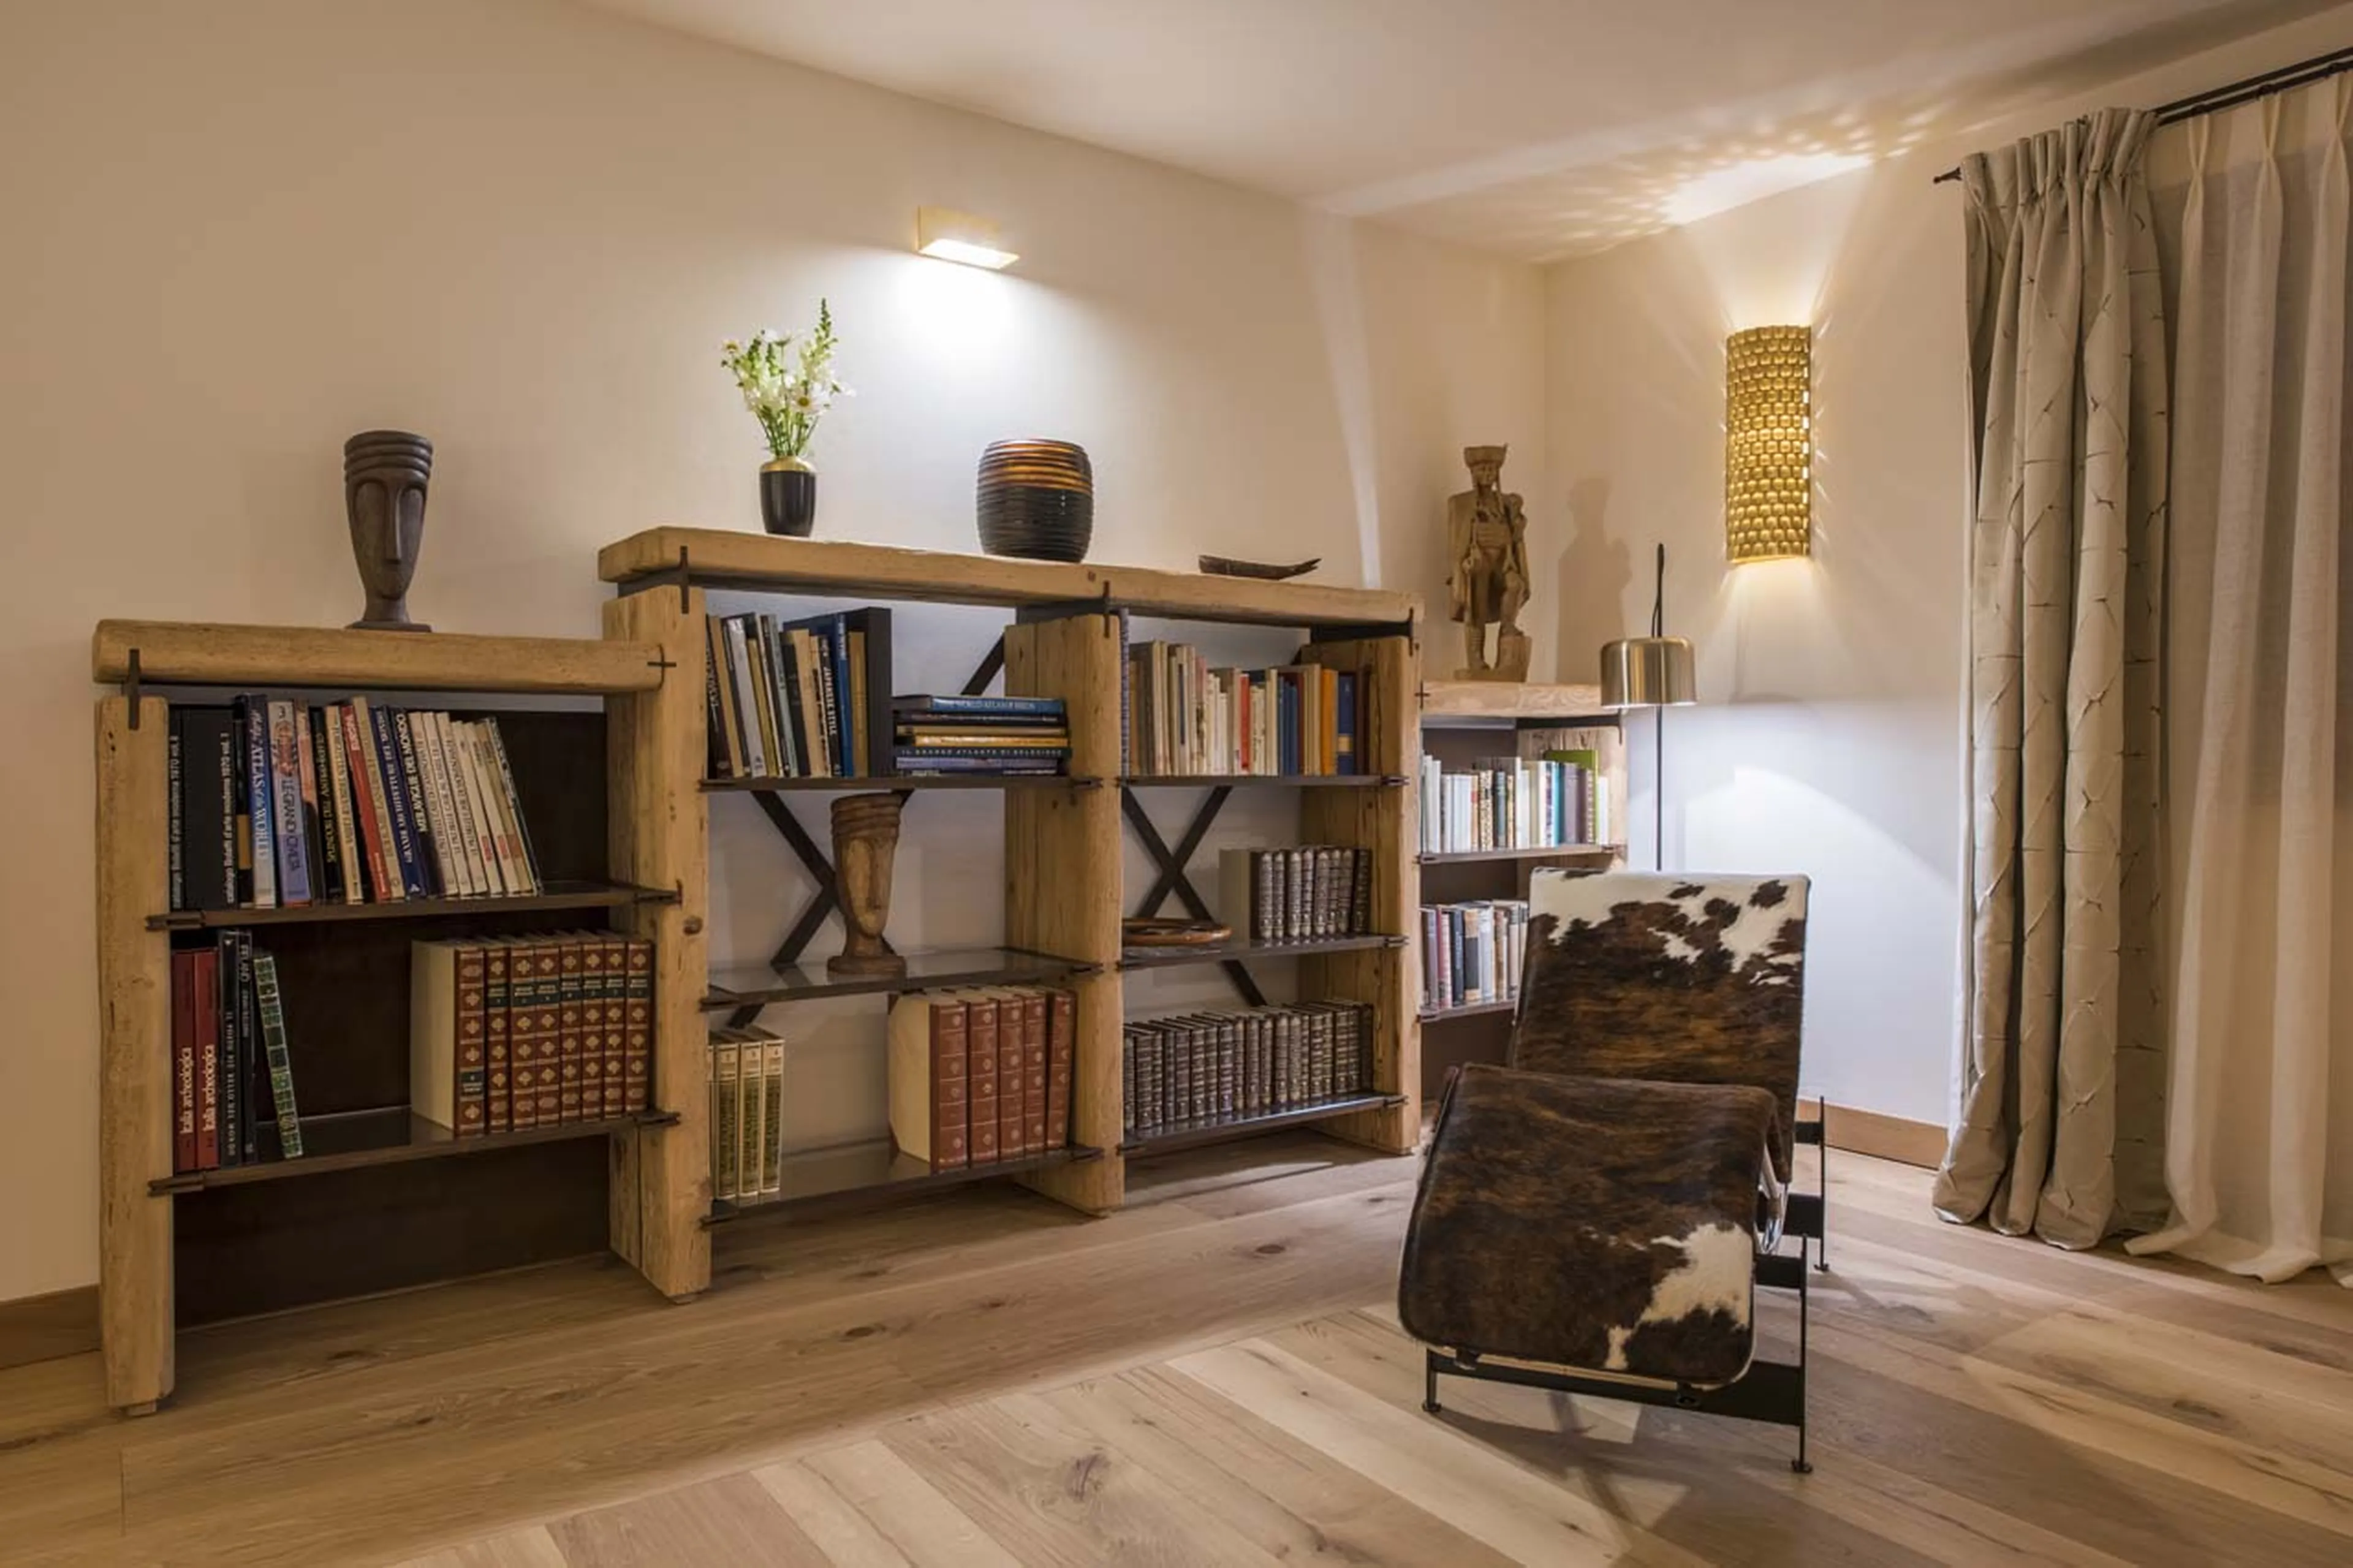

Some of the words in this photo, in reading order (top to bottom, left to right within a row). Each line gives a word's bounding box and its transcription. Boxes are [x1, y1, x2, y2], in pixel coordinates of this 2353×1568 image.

[393, 712, 412, 756] MONDO
[249, 744, 265, 788] ATLAS
[403, 755, 416, 774] DEL
[406, 775, 429, 833] MERAVIGLIE
[253, 808, 270, 860] WORLD
[176, 1047, 195, 1107] archeologica
[200, 1044, 217, 1105] archeologica
[178, 1110, 194, 1134] Italia
[201, 1107, 216, 1131] Italia
